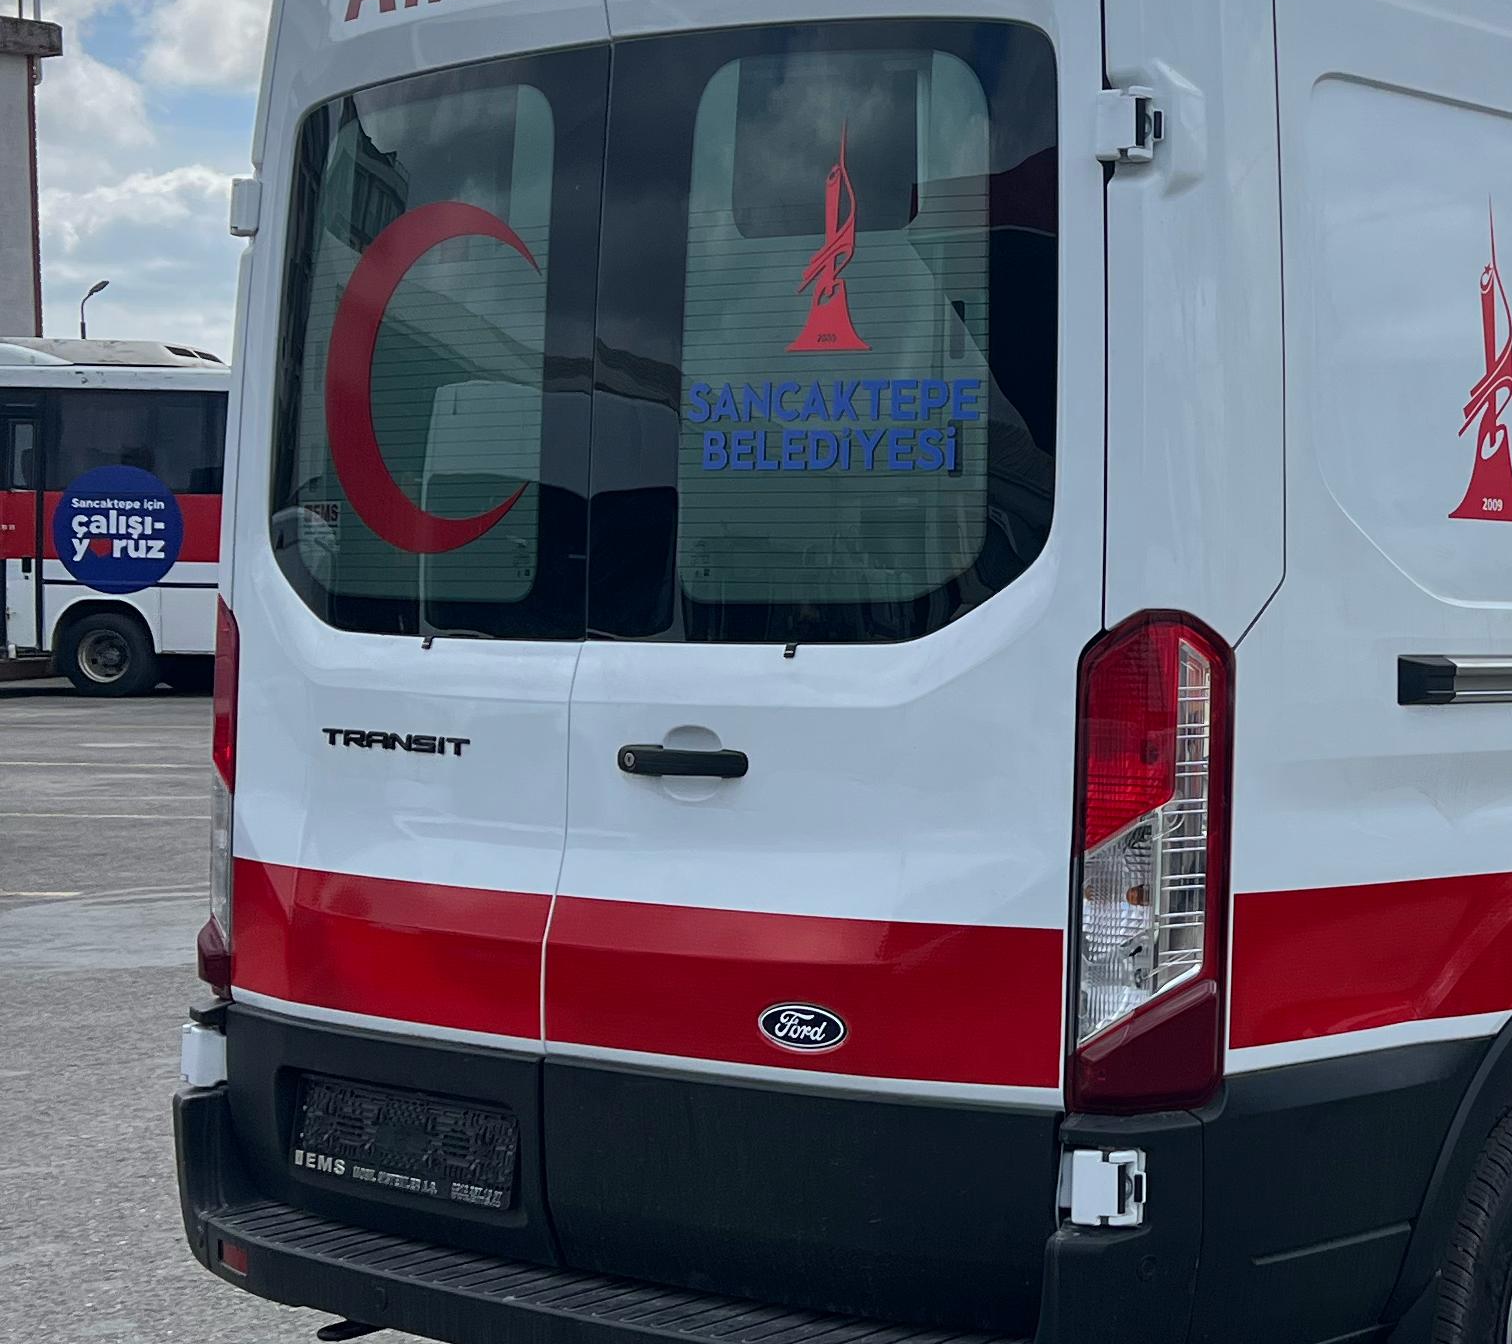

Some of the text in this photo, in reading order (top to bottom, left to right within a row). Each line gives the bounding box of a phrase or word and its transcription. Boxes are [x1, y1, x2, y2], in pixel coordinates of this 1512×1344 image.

[688, 378, 981, 423] SANCAKTEPE
[71, 498, 165, 511] Sancaktepe için
[1482, 497, 1503, 512] 2009
[72, 510, 165, 539] çalışı-
[321, 728, 471, 757] TRANSIT
[774, 1010, 827, 1041] Ford
